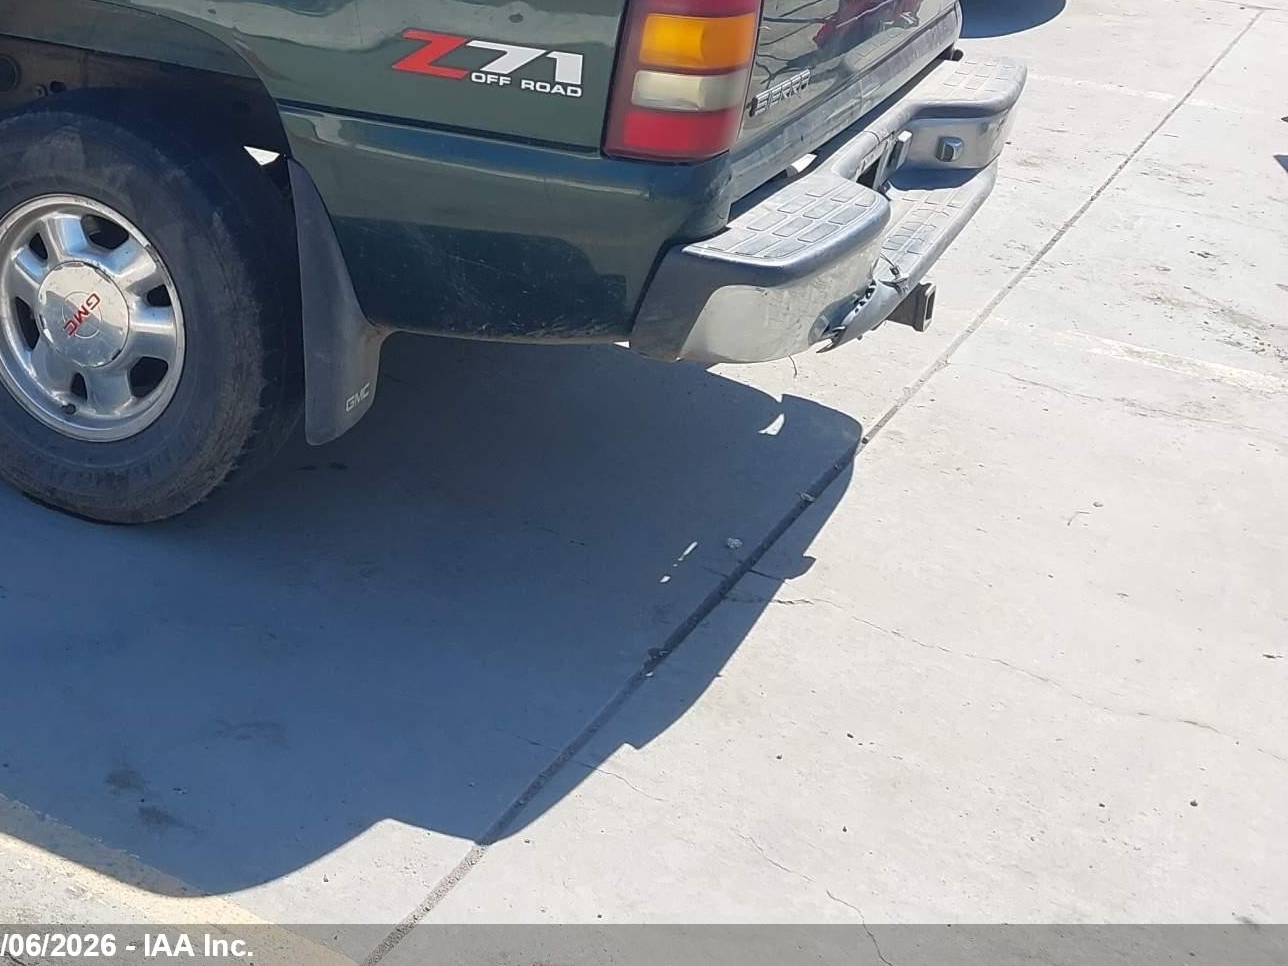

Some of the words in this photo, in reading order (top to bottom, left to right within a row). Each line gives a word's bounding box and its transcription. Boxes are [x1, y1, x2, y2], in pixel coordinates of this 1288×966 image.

[392, 28, 584, 85] Z71
[471, 72, 511, 86] OFF
[520, 79, 582, 97] ROAD
[750, 68, 811, 117] SIERRA
[61, 292, 102, 338] GMC
[345, 382, 371, 412] GMC
